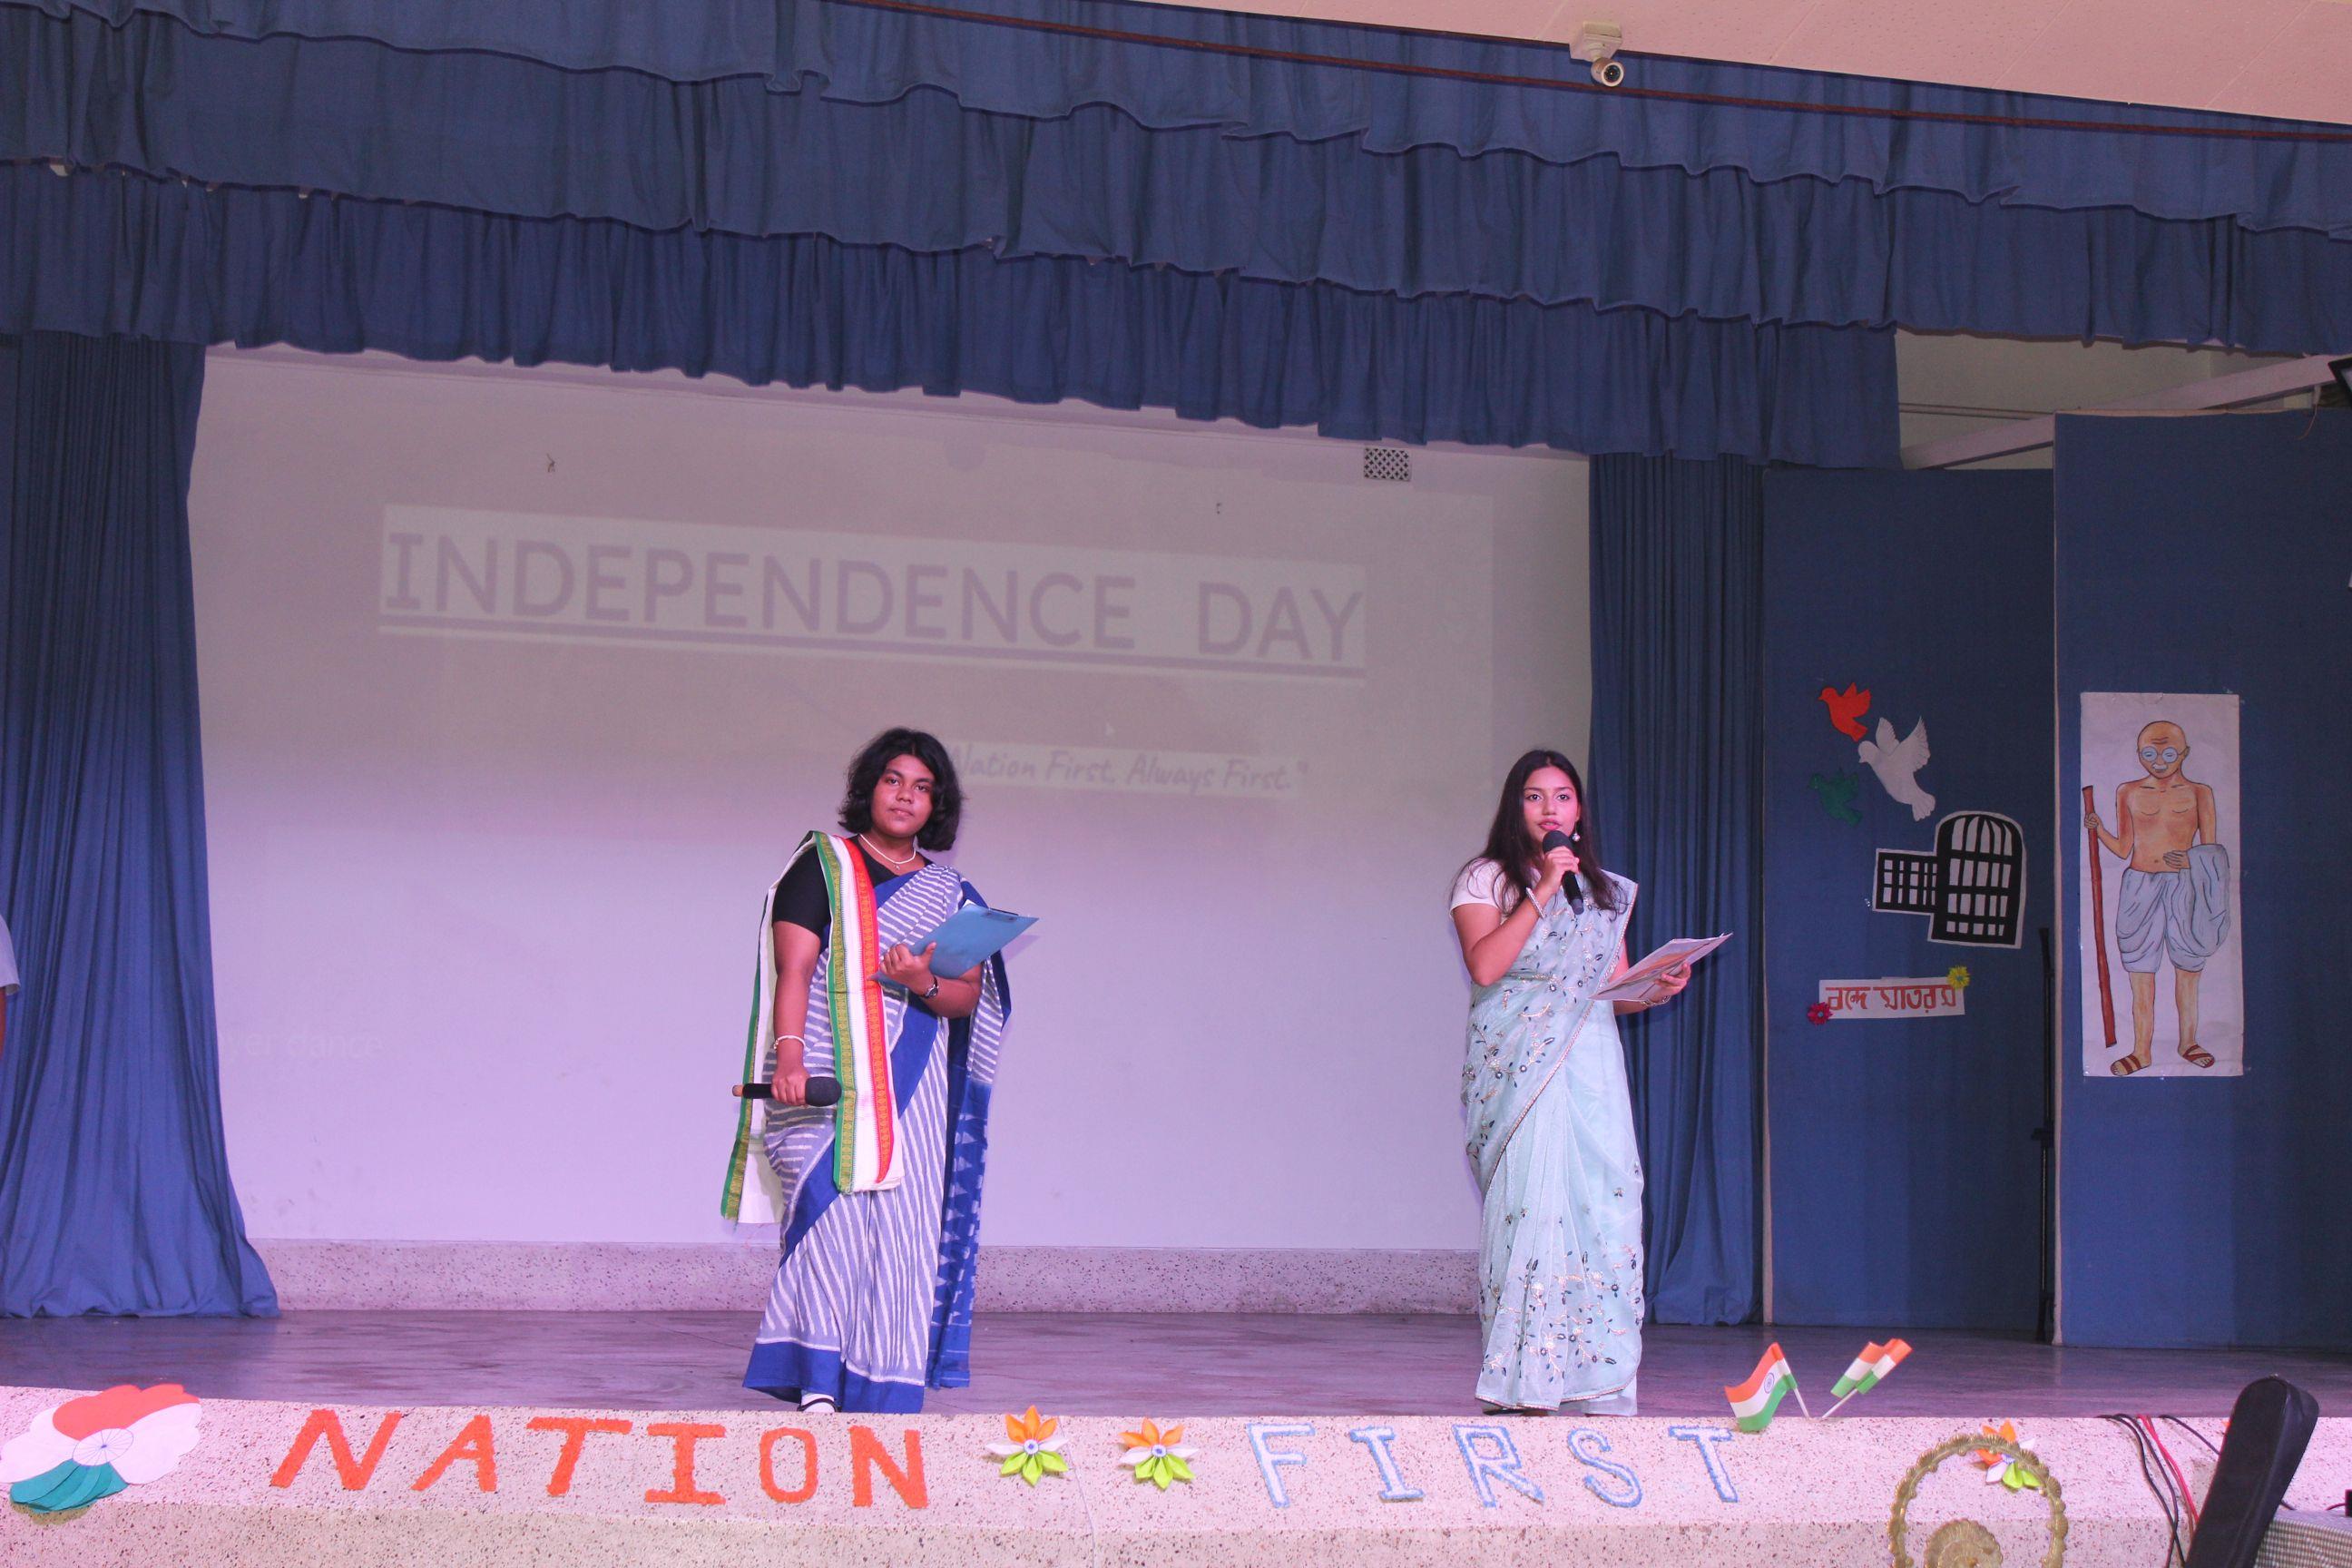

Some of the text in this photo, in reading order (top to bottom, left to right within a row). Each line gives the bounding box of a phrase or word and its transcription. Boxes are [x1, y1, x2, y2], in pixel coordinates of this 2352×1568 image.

[385, 532, 1364, 662] INDEPENDENCE DAY
[1123, 752, 1214, 794] Always
[270, 1408, 1739, 1509] NATION FIRST
